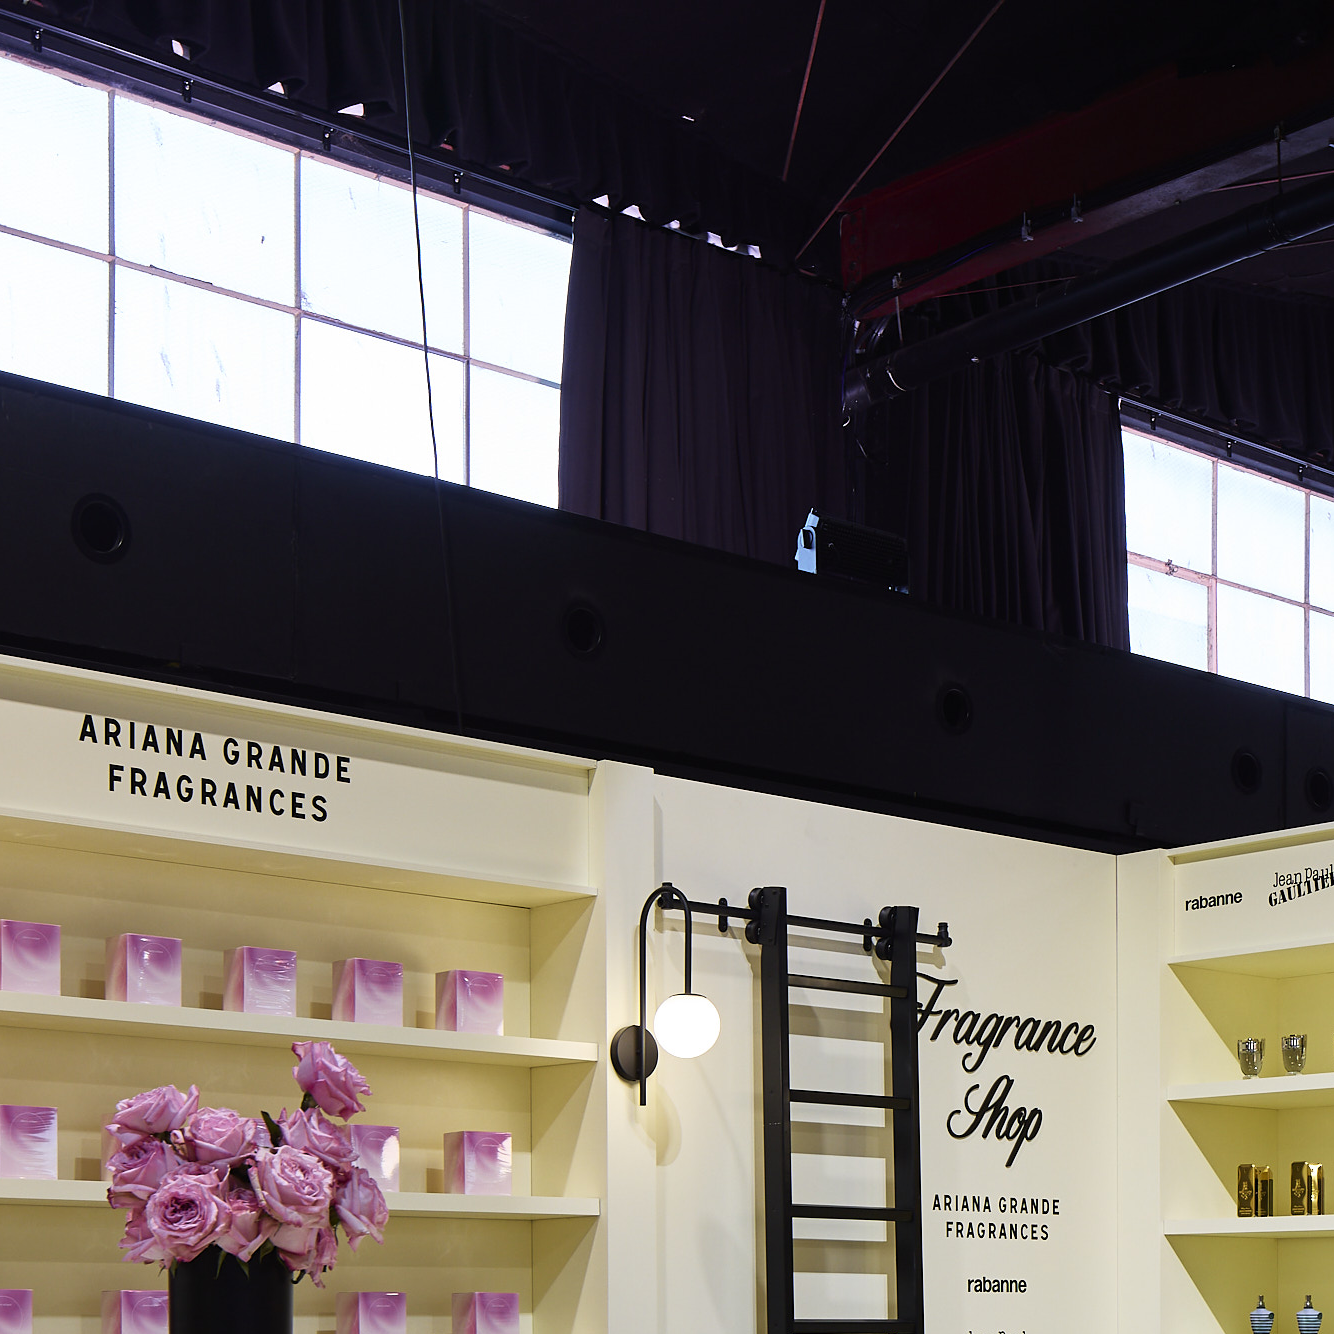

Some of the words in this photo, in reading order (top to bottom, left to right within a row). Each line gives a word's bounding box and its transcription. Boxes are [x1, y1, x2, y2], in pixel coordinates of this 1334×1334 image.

[78, 714, 207, 761] ARIANA
[223, 737, 351, 784] GRANDE
[108, 763, 328, 823] FRAGRANCES
[1273, 871, 1302, 888] Jean
[1305, 864, 1334, 884] Paul
[1185, 891, 1243, 912] rabanne
[917, 972, 1096, 1073] Fragrance
[947, 1075, 1042, 1167] Shop
[932, 1194, 992, 1213] ARIANA
[998, 1196, 1060, 1216] GRANDE
[946, 1221, 1049, 1241] FRAGRANCES
[967, 1276, 1028, 1294] rabanne
